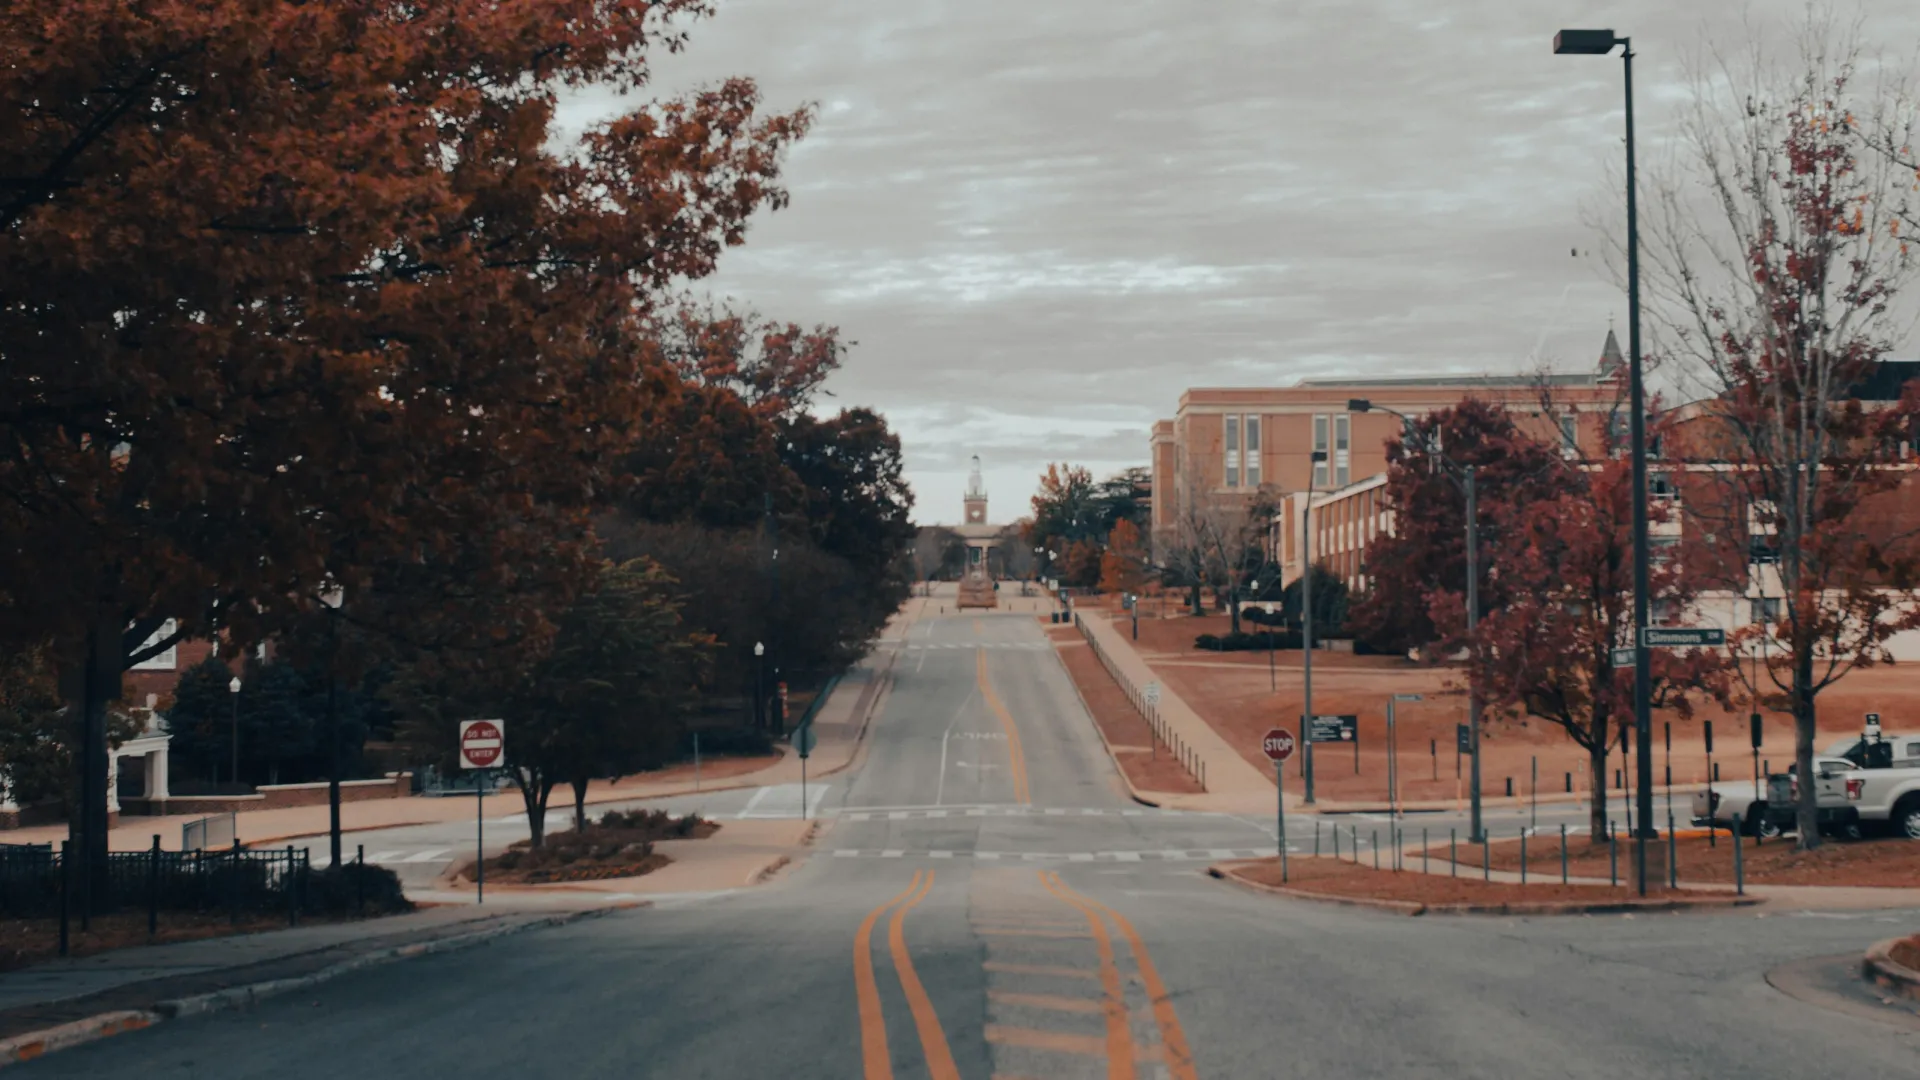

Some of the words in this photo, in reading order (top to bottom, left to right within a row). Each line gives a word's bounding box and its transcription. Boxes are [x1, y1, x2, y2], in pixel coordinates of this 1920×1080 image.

[1647, 631, 1702, 643] Simmons
[467, 730, 478, 738] DO
[481, 729, 497, 737] NOT
[1264, 738, 1293, 752] STOP
[469, 750, 494, 758] ENTER
